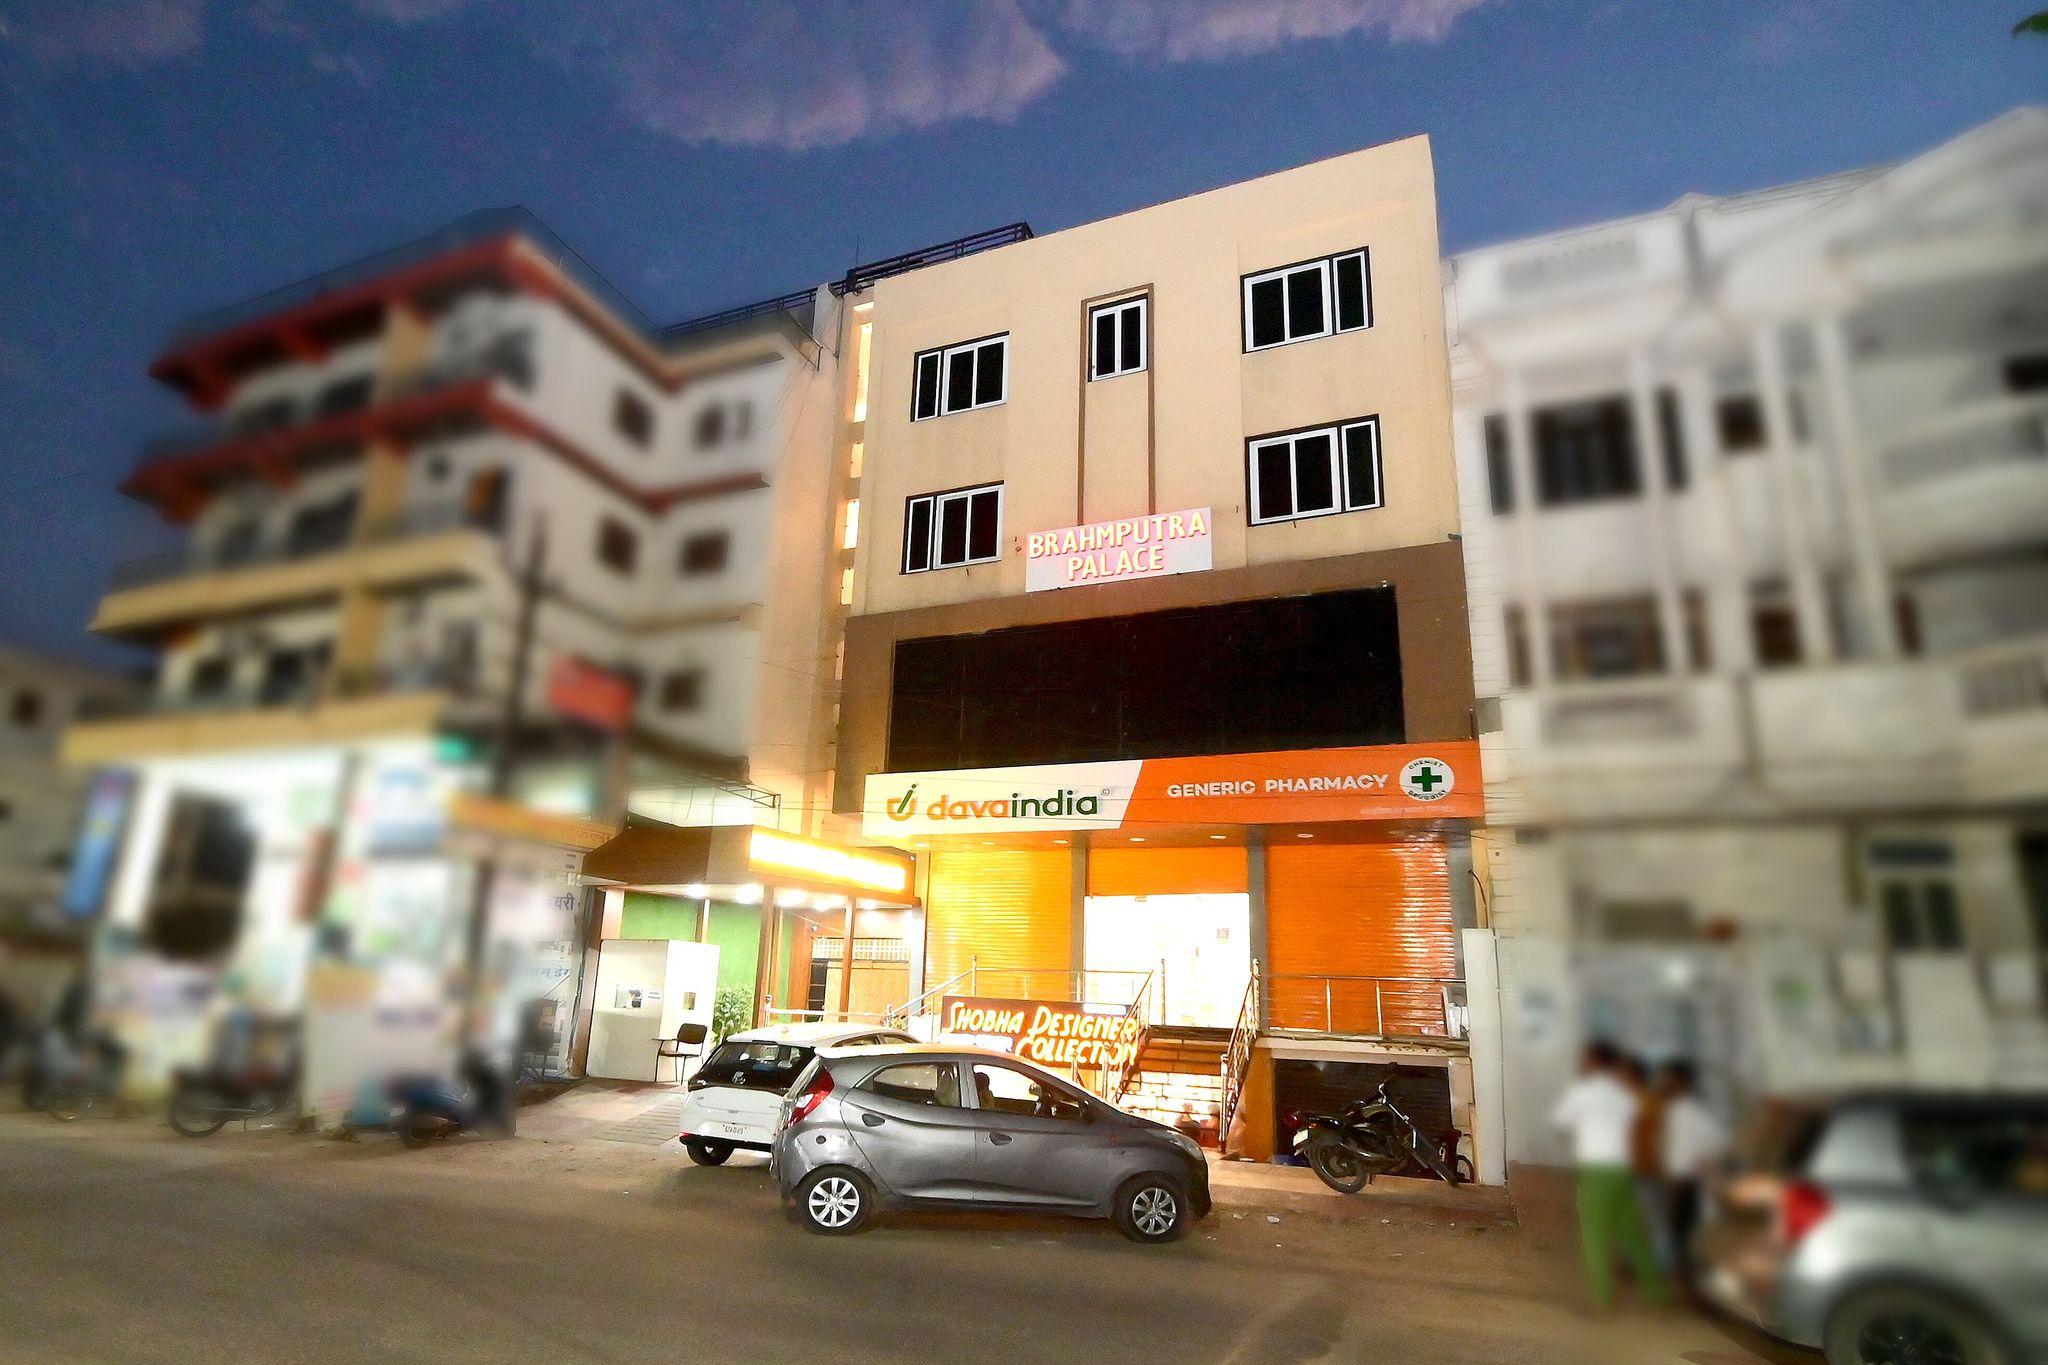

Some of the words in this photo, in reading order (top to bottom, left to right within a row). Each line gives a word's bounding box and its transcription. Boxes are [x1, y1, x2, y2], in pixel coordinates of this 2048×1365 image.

[1028, 511, 1208, 559] BRAHMPUTRA
[1067, 544, 1165, 581] PALACE
[1408, 759, 1444, 770] CHEMIST
[1166, 780, 1257, 798] GENERIC
[1265, 773, 1389, 793] PHARMACY
[926, 789, 1099, 821] davaindia
[942, 1001, 1026, 1034] SHOBHA
[1027, 1005, 1138, 1042] DESIGNER
